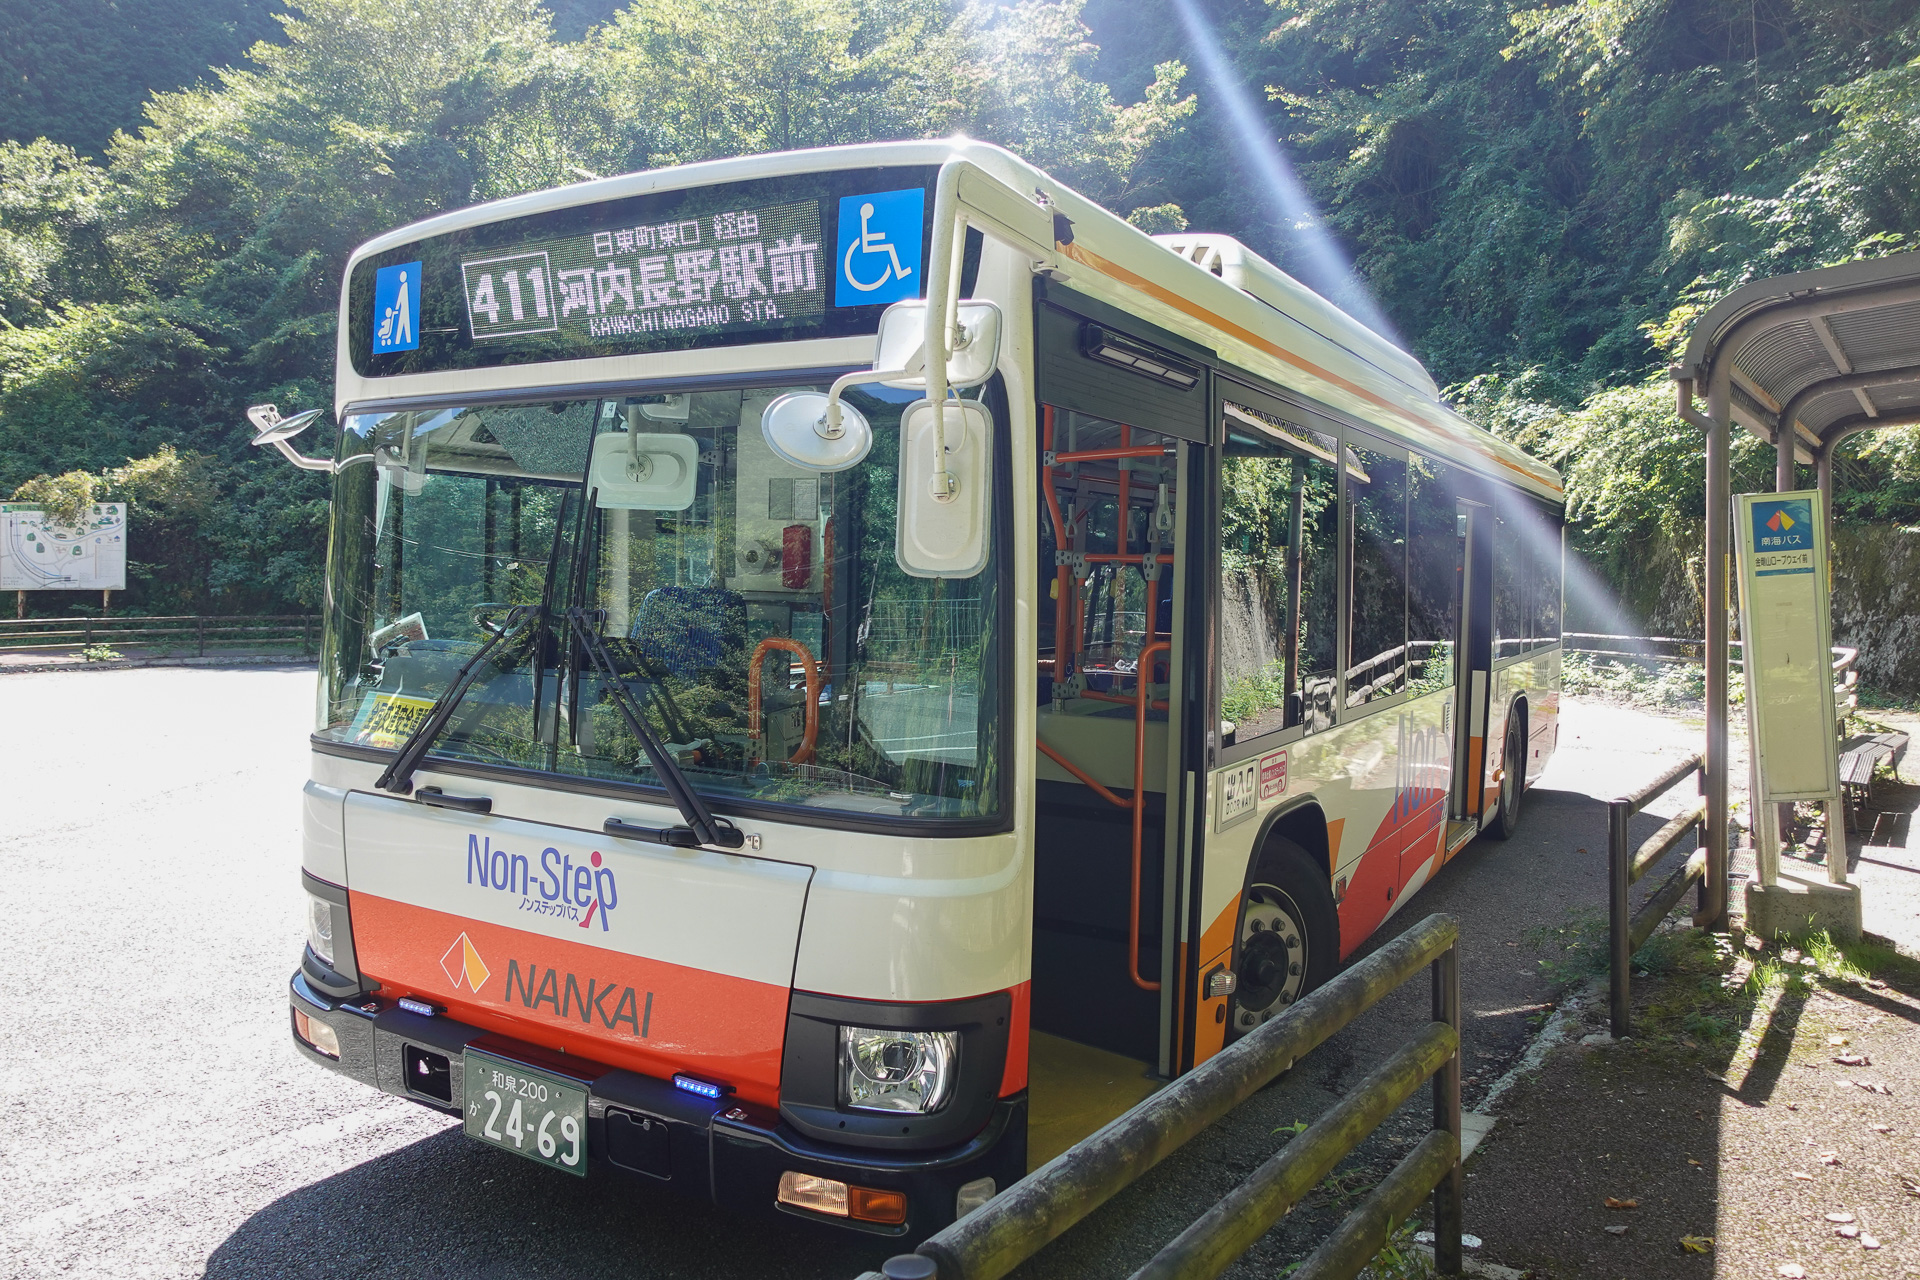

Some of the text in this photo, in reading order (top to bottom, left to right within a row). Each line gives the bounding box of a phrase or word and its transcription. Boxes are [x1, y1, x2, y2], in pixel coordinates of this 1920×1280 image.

[593, 210, 759, 257] 日東町東口 経由
[472, 266, 549, 324] 411
[557, 233, 819, 318] 河内長野駅前
[1761, 534, 1802, 547] 南海バス
[1226, 766, 1254, 801] 出入口
[467, 833, 618, 932] Non-Step
[518, 897, 579, 922] ノンステップバス
[505, 959, 654, 1039] NANKAI
[468, 1100, 481, 1117] か
[484, 1090, 580, 1166] 24-69
